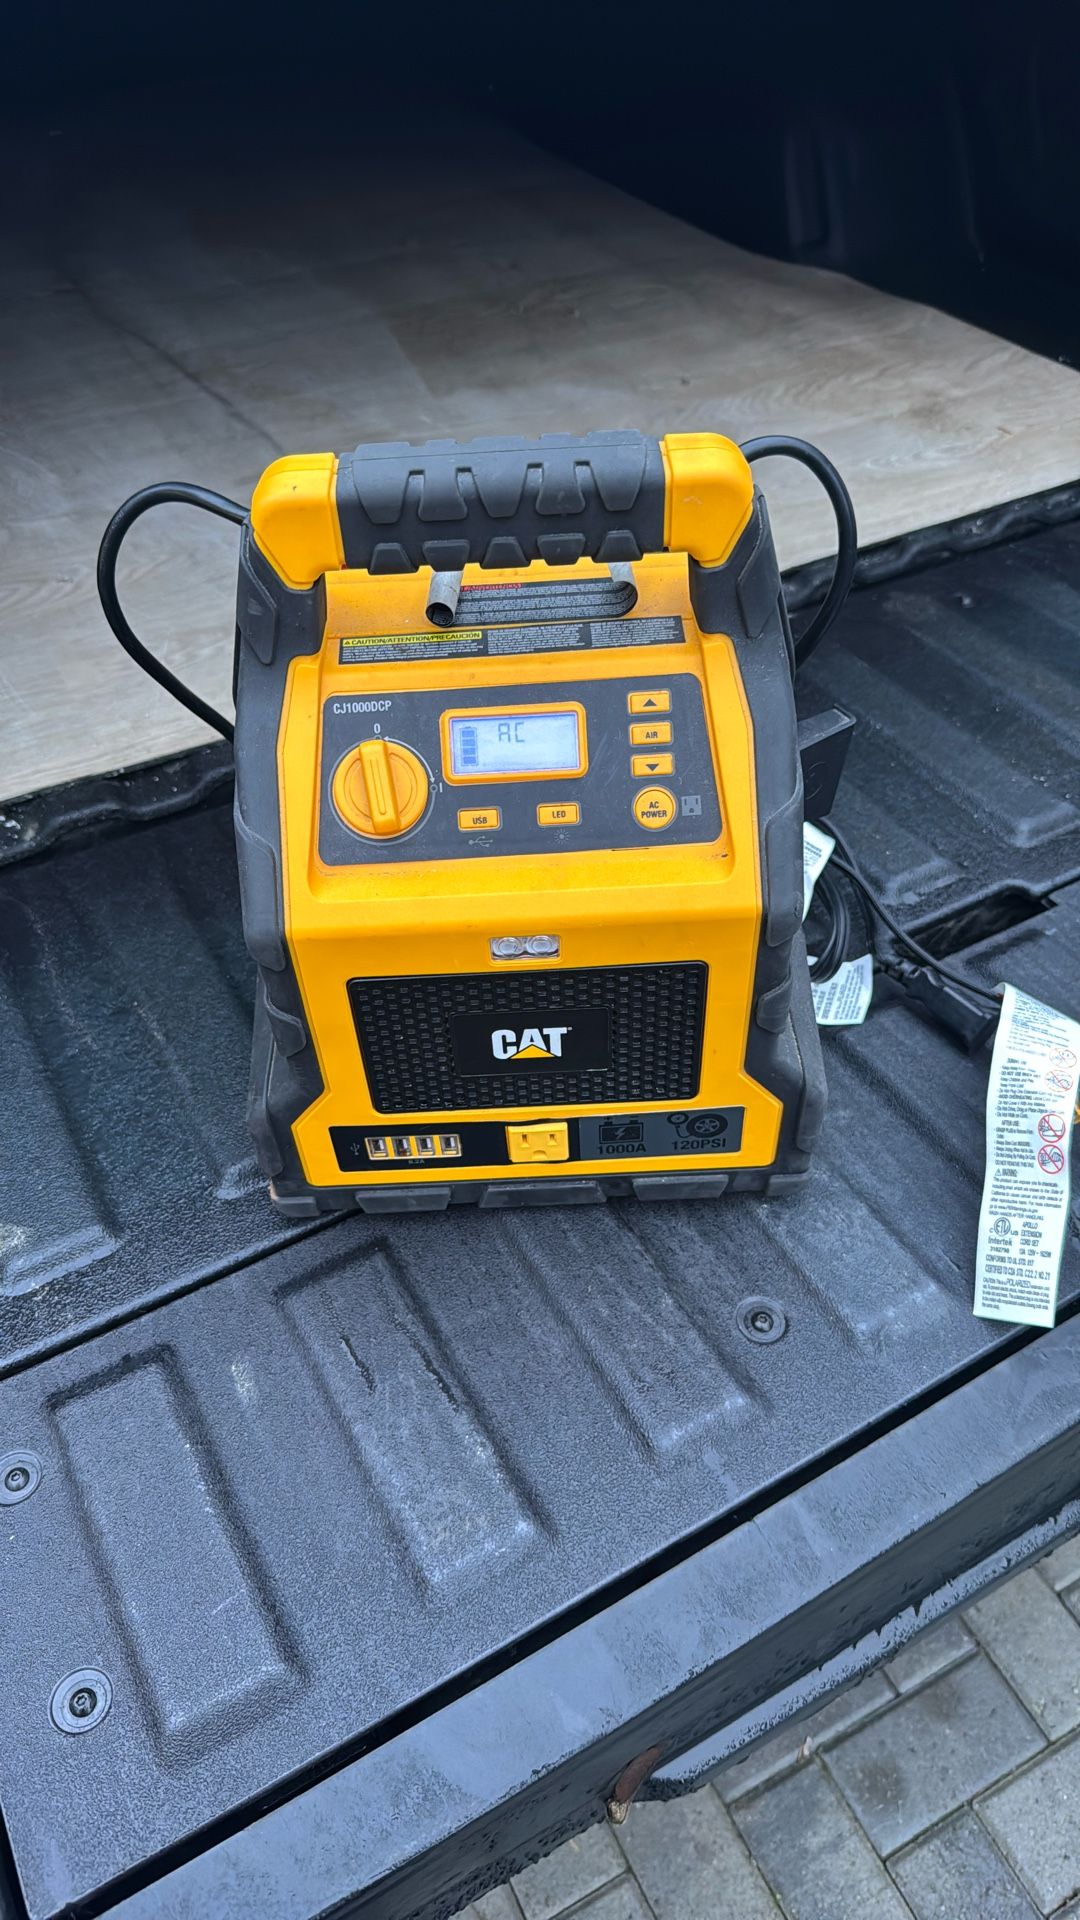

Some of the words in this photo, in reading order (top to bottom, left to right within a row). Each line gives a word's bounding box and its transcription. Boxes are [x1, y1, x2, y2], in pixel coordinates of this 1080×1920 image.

[334, 700, 392, 714] CJ1000DCP
[498, 722, 525, 742] AC
[649, 801, 659, 809] AC
[641, 810, 667, 818] POWER
[492, 1027, 568, 1060] CAT
[598, 1143, 646, 1155] 1000A
[672, 1138, 726, 1150] 120PSI
[988, 1236, 1012, 1246] Intertek
